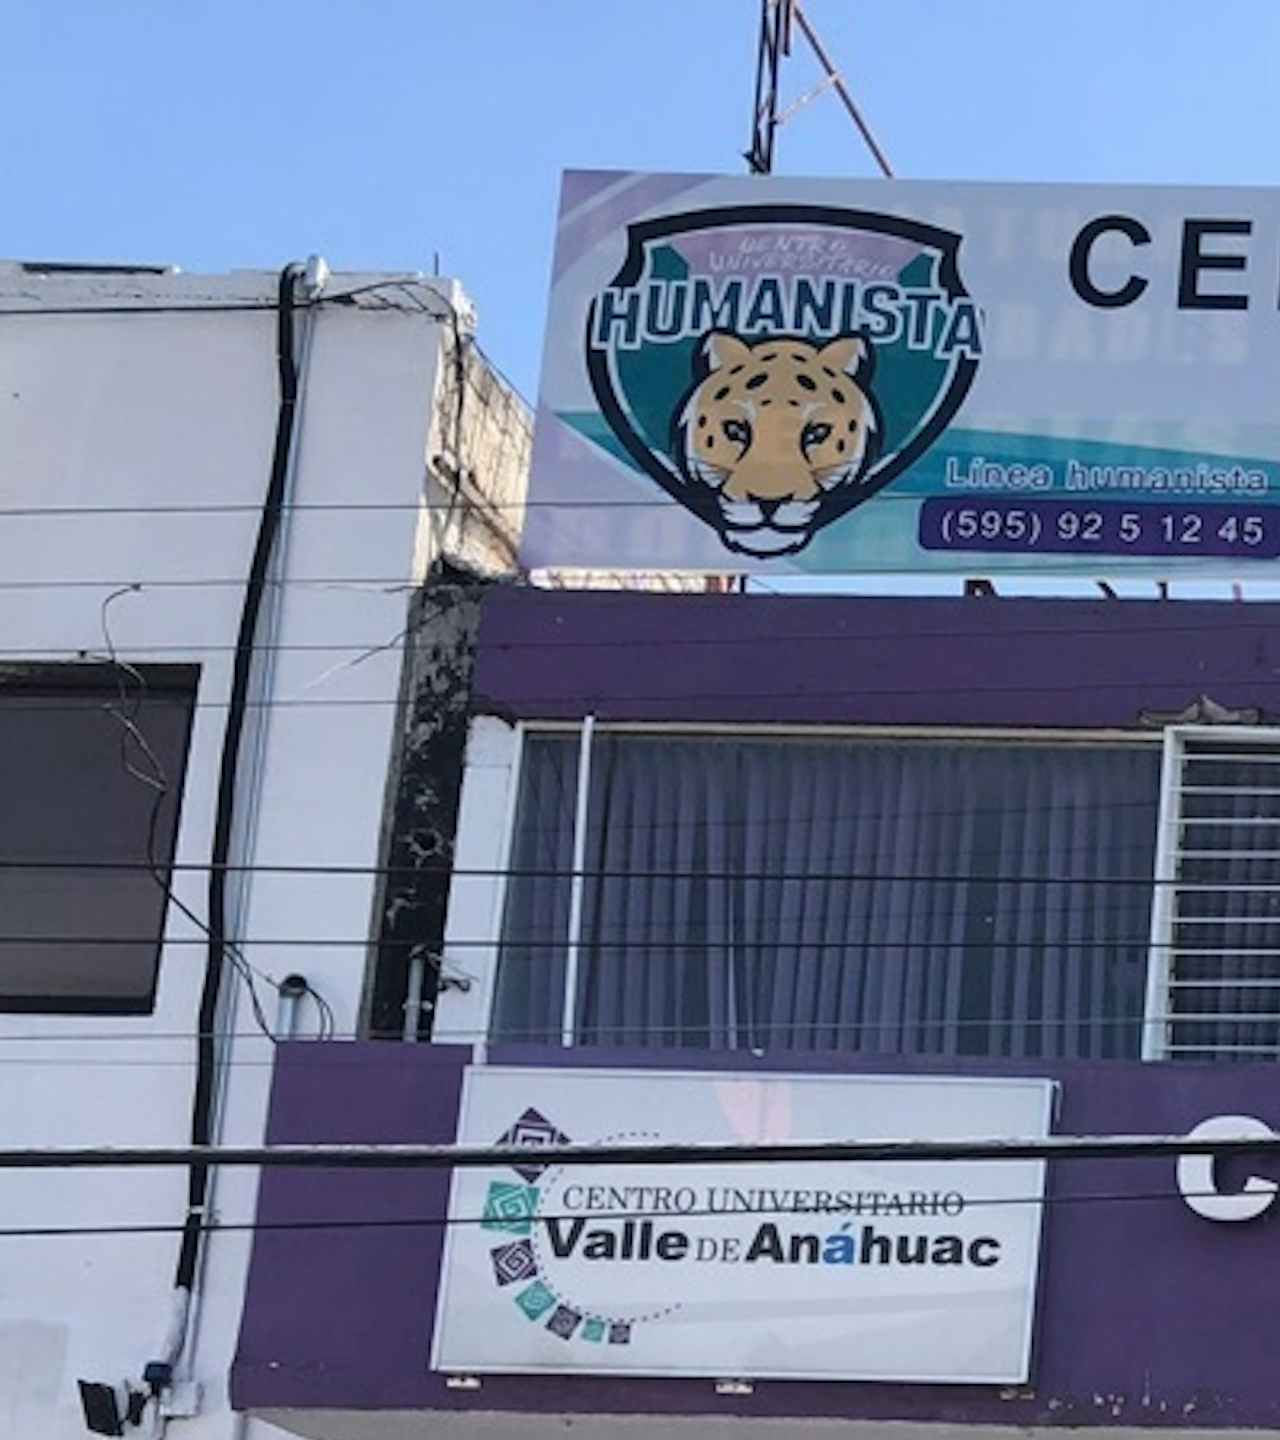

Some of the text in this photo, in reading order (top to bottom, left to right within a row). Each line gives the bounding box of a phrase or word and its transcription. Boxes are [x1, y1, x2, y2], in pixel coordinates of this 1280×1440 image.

[592, 277, 985, 360] HUMANISTA
[946, 457, 1269, 496] Línea humanista
[941, 510, 1264, 545] (595) 92 5 12 45
[561, 1185, 966, 1217] CENTRO UNIVERSITARIO
[544, 1216, 1002, 1268] Valle DE Anáhuac
